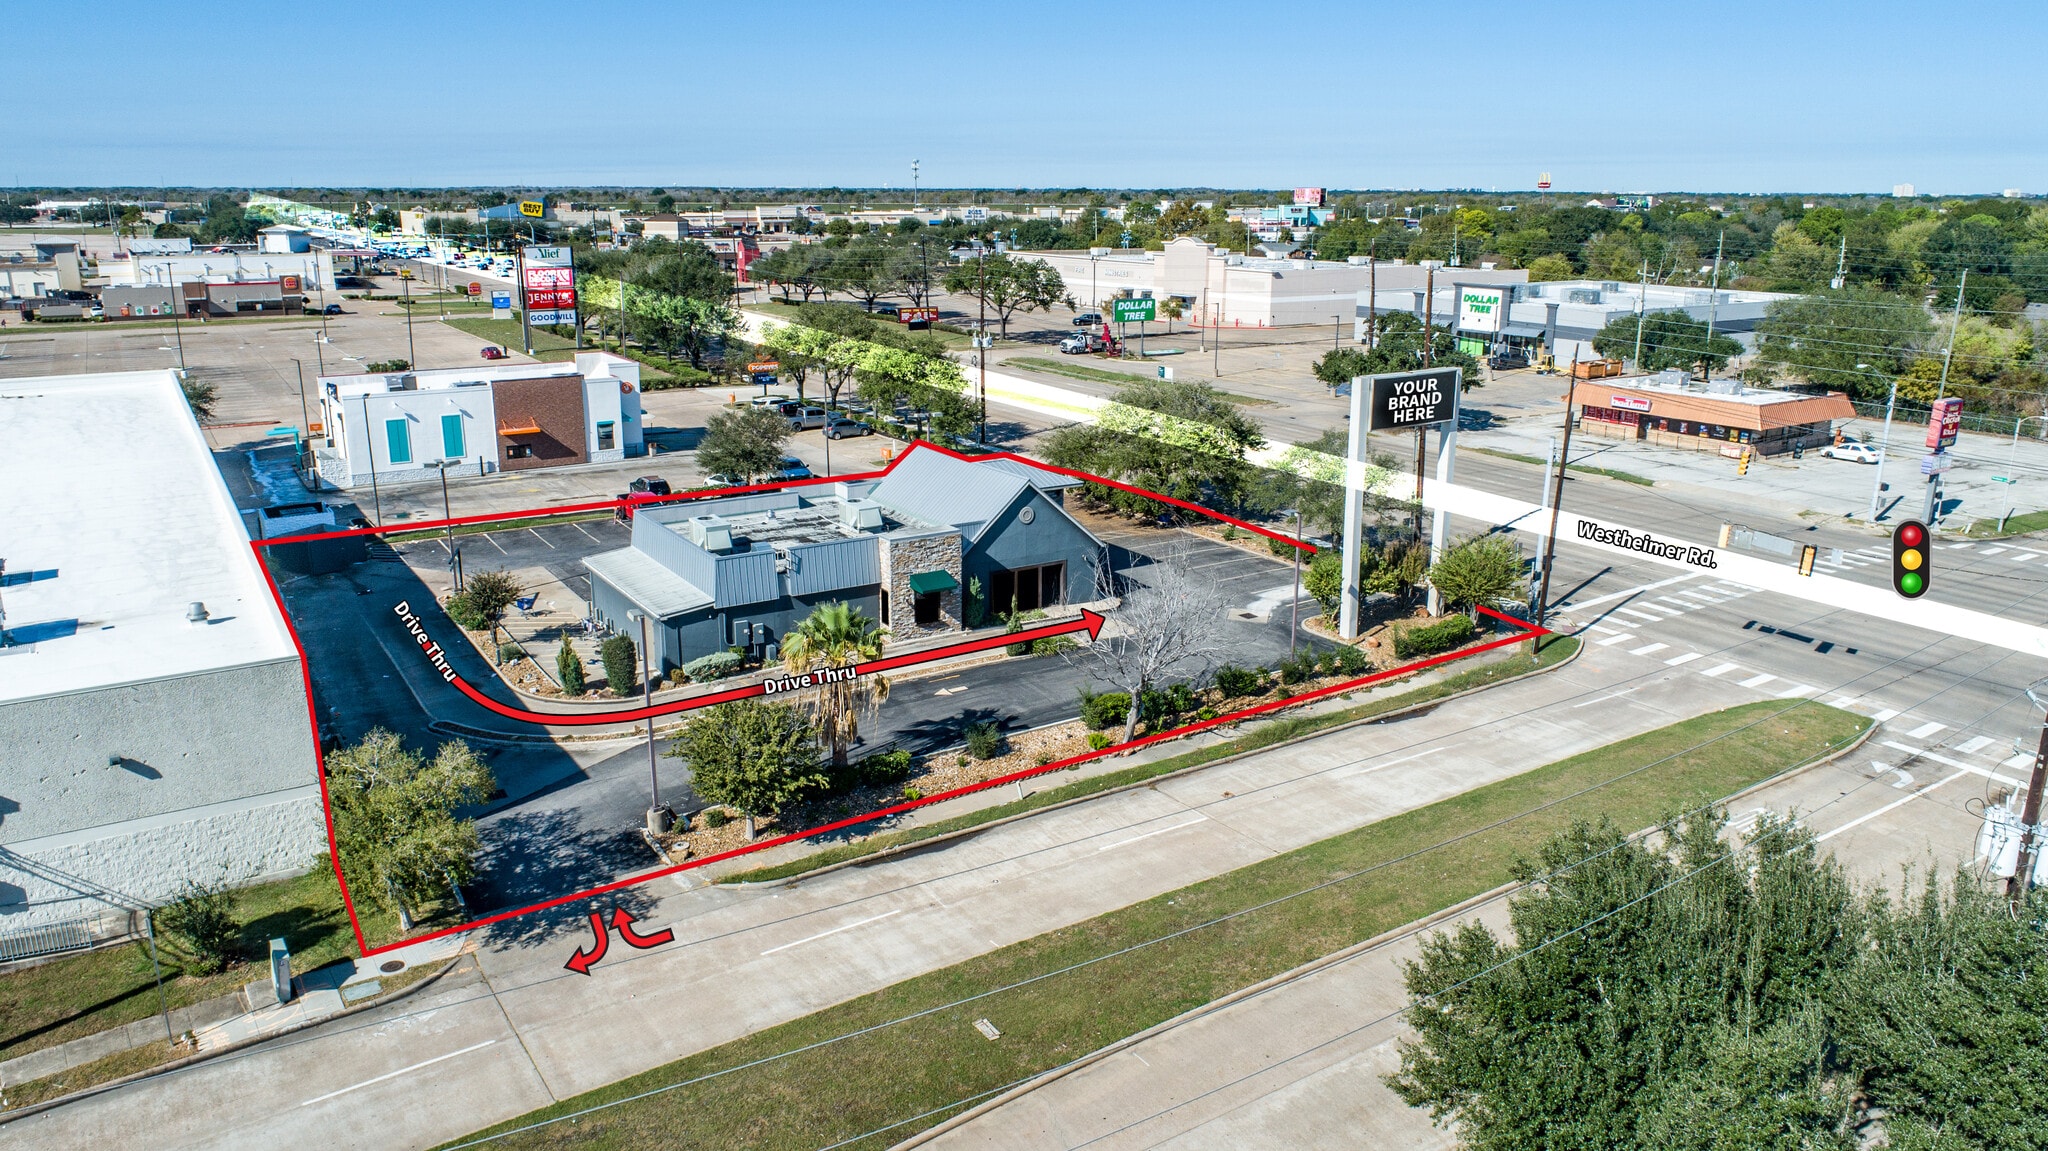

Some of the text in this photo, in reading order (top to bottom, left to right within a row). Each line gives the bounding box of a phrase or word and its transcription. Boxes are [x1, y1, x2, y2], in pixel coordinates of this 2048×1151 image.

[1463, 294, 1500, 305] DOLLAR
[1118, 301, 1153, 311] DOLLAR
[1469, 304, 1492, 314] TREE
[530, 313, 574, 322] GOODWILL
[1124, 311, 1146, 321] TREE
[1394, 378, 1438, 395] YOUR
[1388, 391, 1442, 410] BRAND
[1393, 406, 1435, 423] HERE
